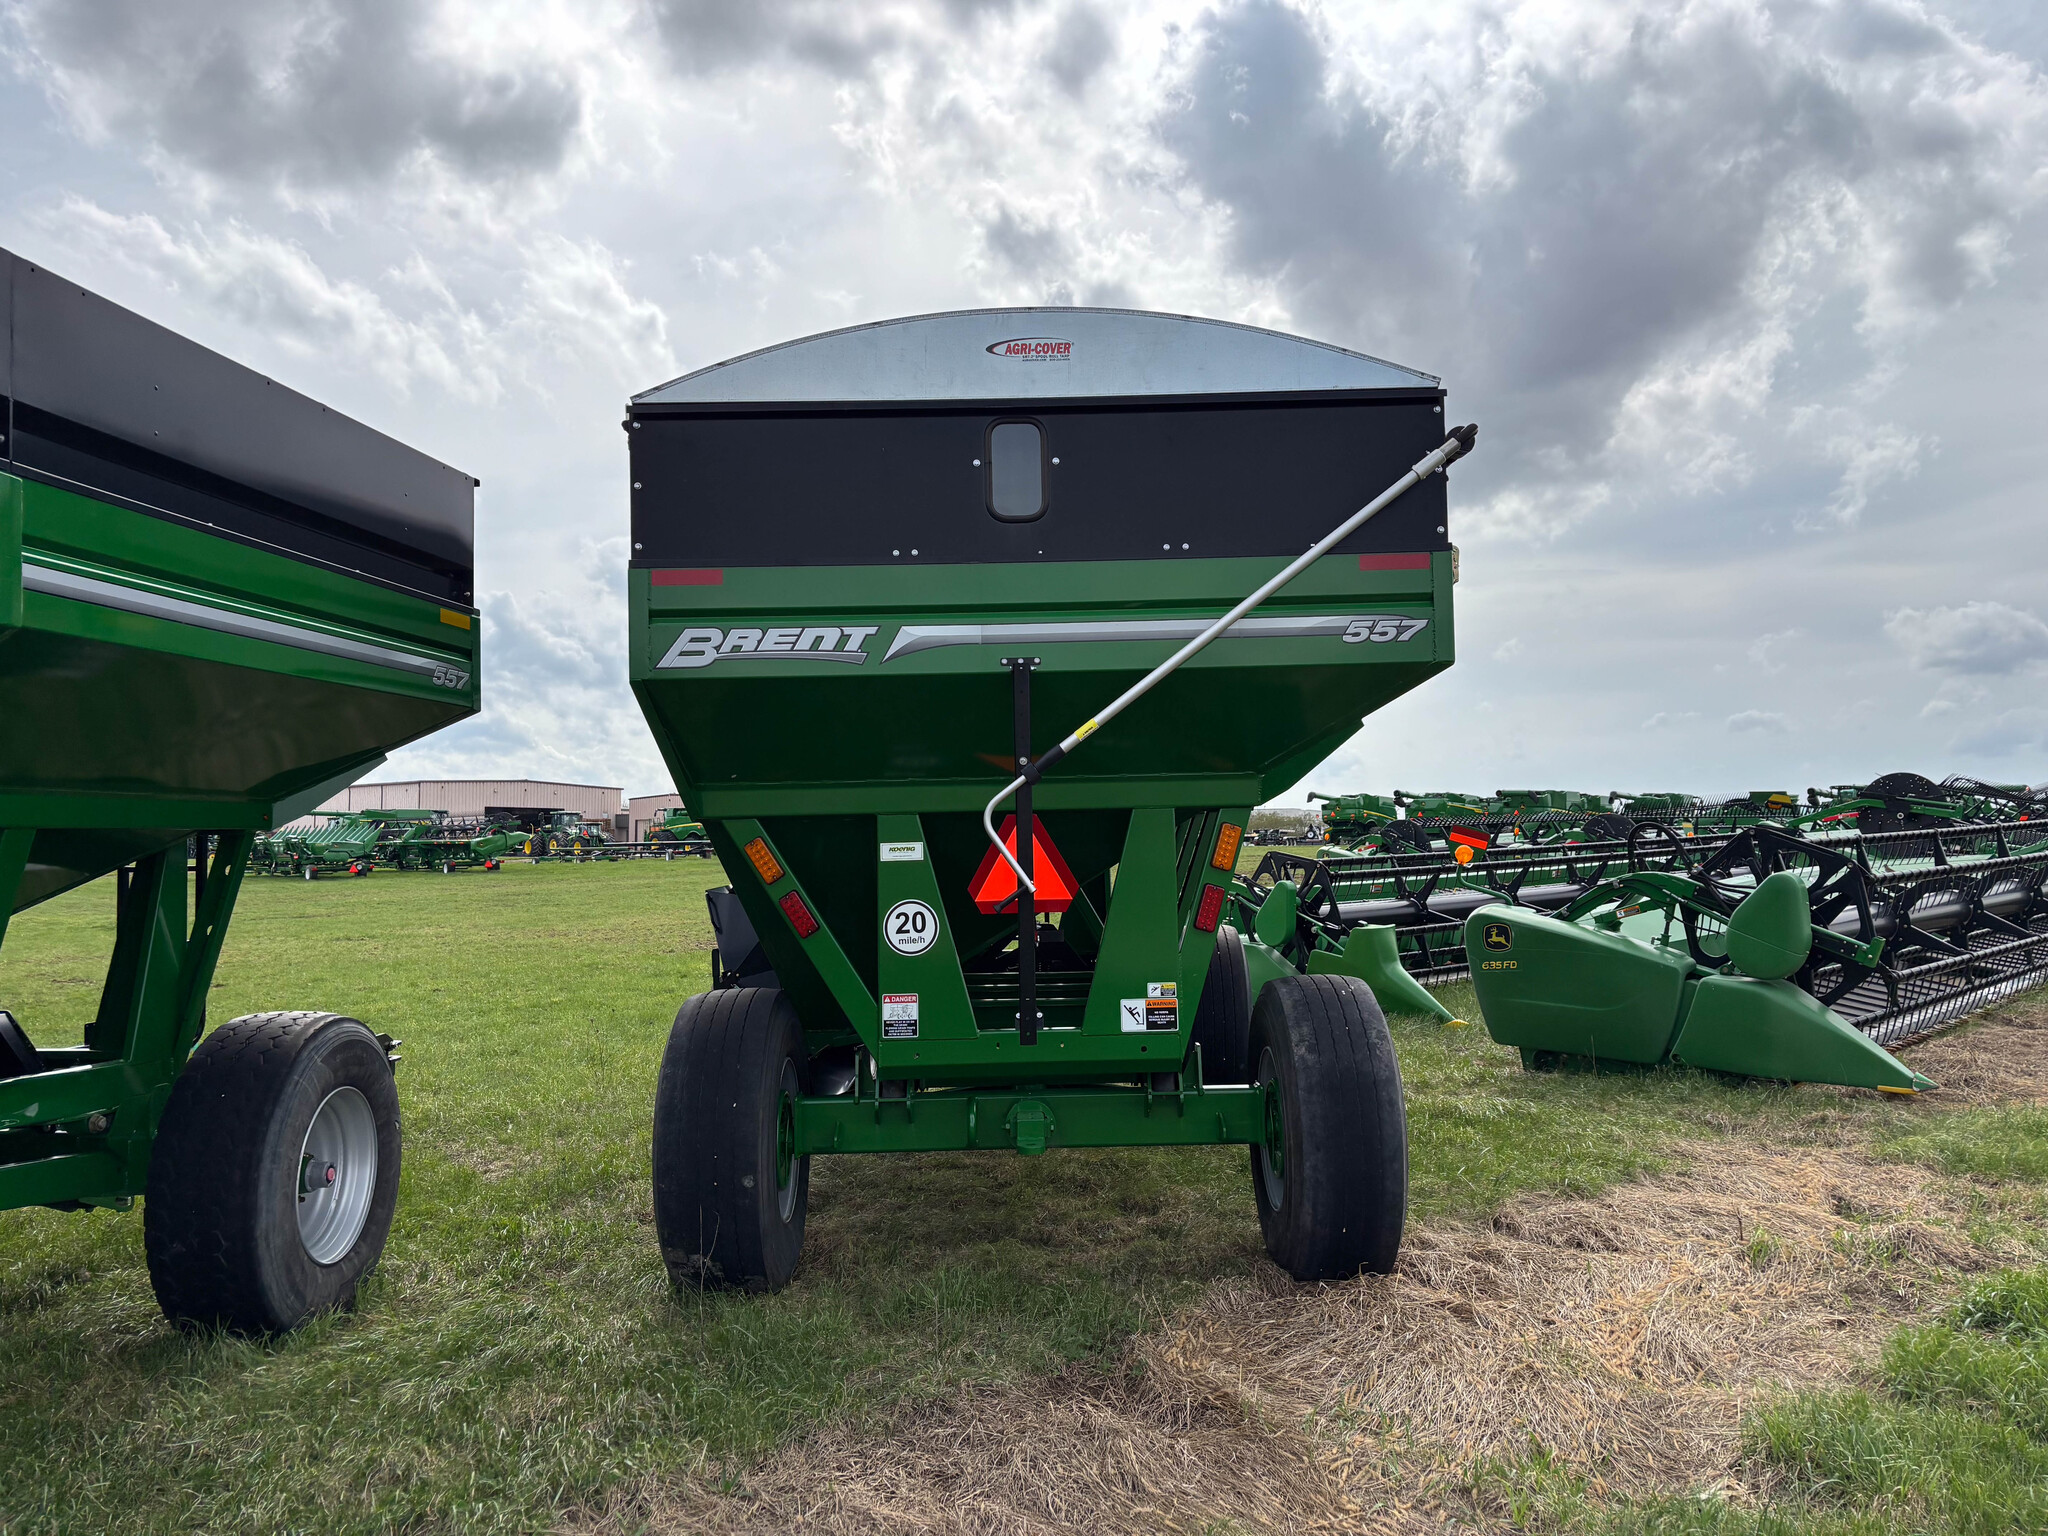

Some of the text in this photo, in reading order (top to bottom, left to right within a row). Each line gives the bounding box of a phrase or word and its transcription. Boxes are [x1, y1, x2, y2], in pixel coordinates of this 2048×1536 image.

[1005, 342, 1071, 355] AGRI-COVER
[1342, 619, 1430, 644] 557
[654, 626, 880, 669] BRENT
[432, 665, 470, 690] 557
[895, 911, 927, 934] 20
[898, 936, 926, 945] mile/h
[1482, 960, 1518, 970] 635 FD
